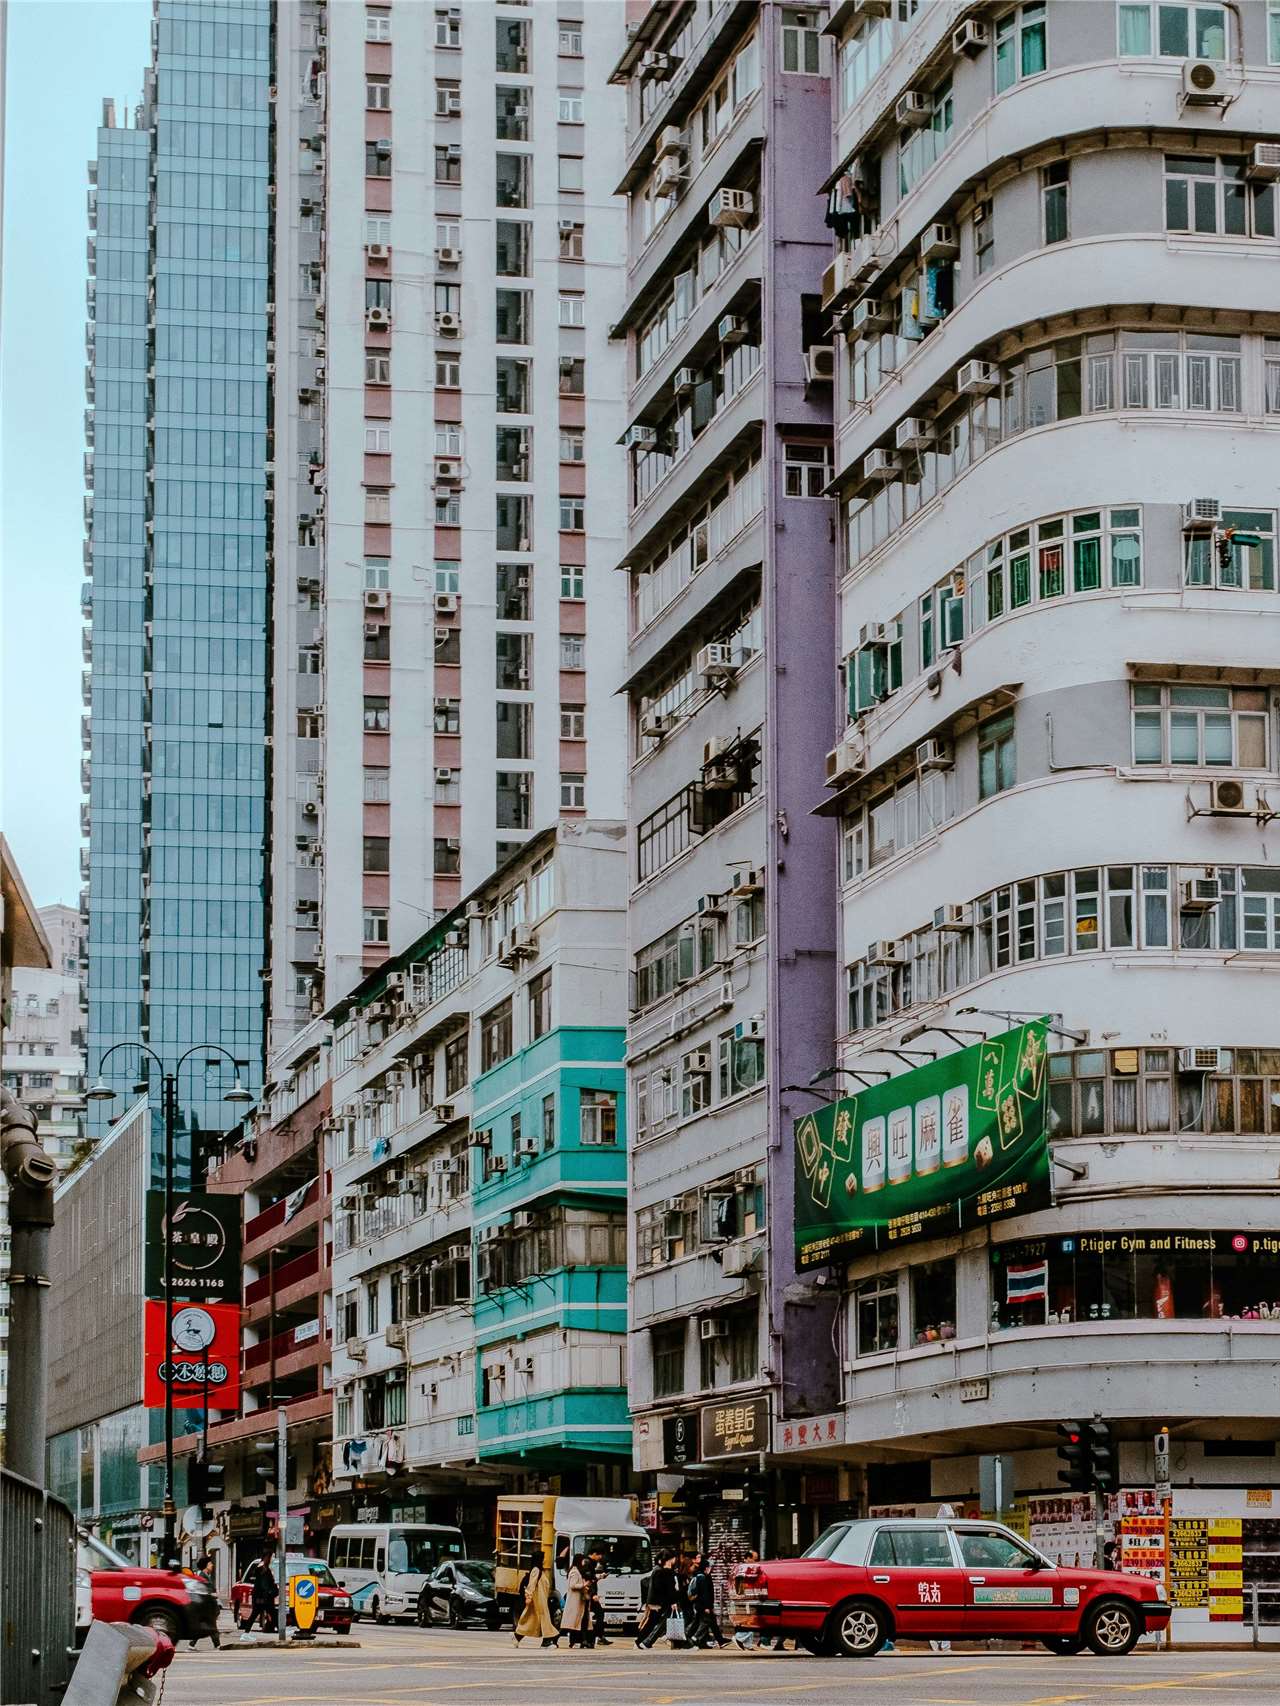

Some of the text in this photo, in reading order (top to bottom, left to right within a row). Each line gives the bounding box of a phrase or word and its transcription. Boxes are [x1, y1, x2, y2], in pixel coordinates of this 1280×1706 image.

[866, 1095, 964, 1175] 興旺麻雀
[1080, 1236, 1217, 1253] P.tiger Gym and Fitness
[171, 1277, 225, 1288] 2626 1168
[918, 1581, 941, 1592] 的士
[918, 1591, 941, 1603] TAXI
